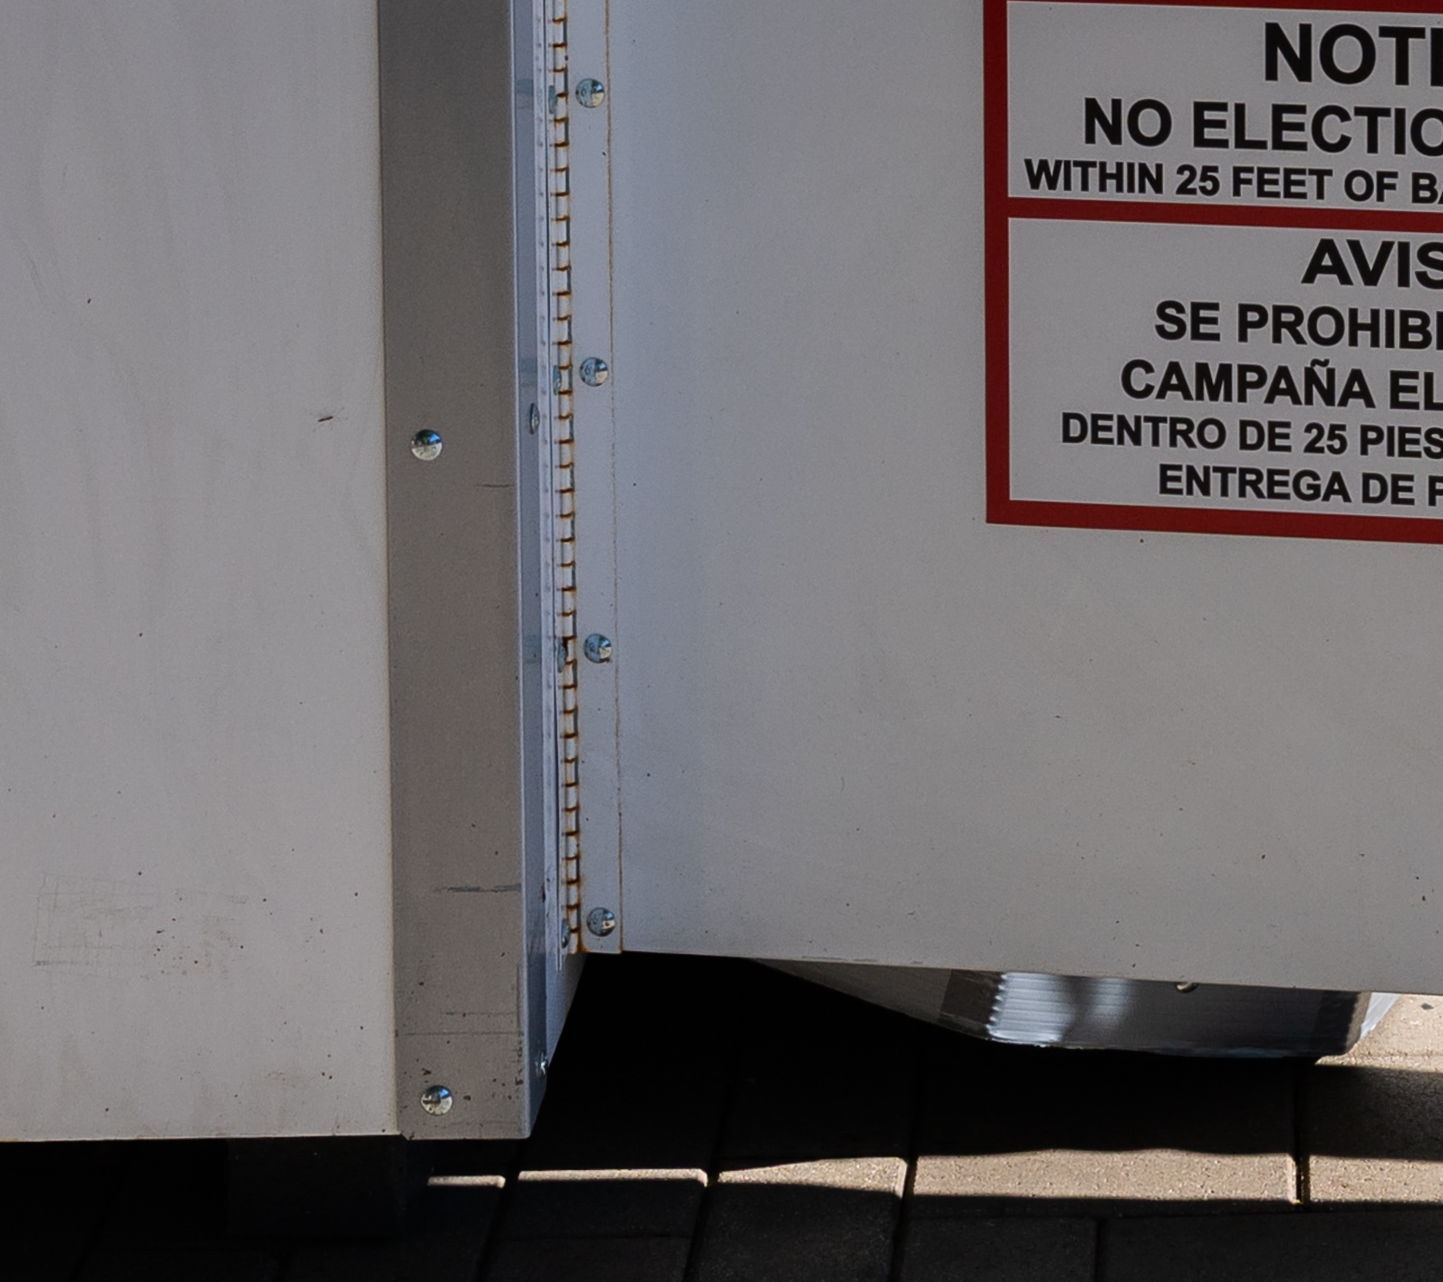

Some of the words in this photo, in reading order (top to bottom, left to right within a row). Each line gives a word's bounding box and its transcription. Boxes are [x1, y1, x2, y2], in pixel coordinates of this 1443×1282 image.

[1085, 98, 1171, 146] NO
[1024, 159, 1163, 194] WITHIN
[1176, 164, 1220, 196] 25
[1233, 166, 1333, 200] FEET
[1345, 170, 1398, 202] OF
[1155, 301, 1220, 341] SE
[1122, 359, 1375, 408] CAMPAÑA
[1063, 412, 1226, 449] DENTRO
[1240, 420, 1291, 452] DE
[1304, 423, 1347, 454] 25
[1160, 464, 1351, 502] ENTREGA
[1362, 473, 1414, 505] DE
